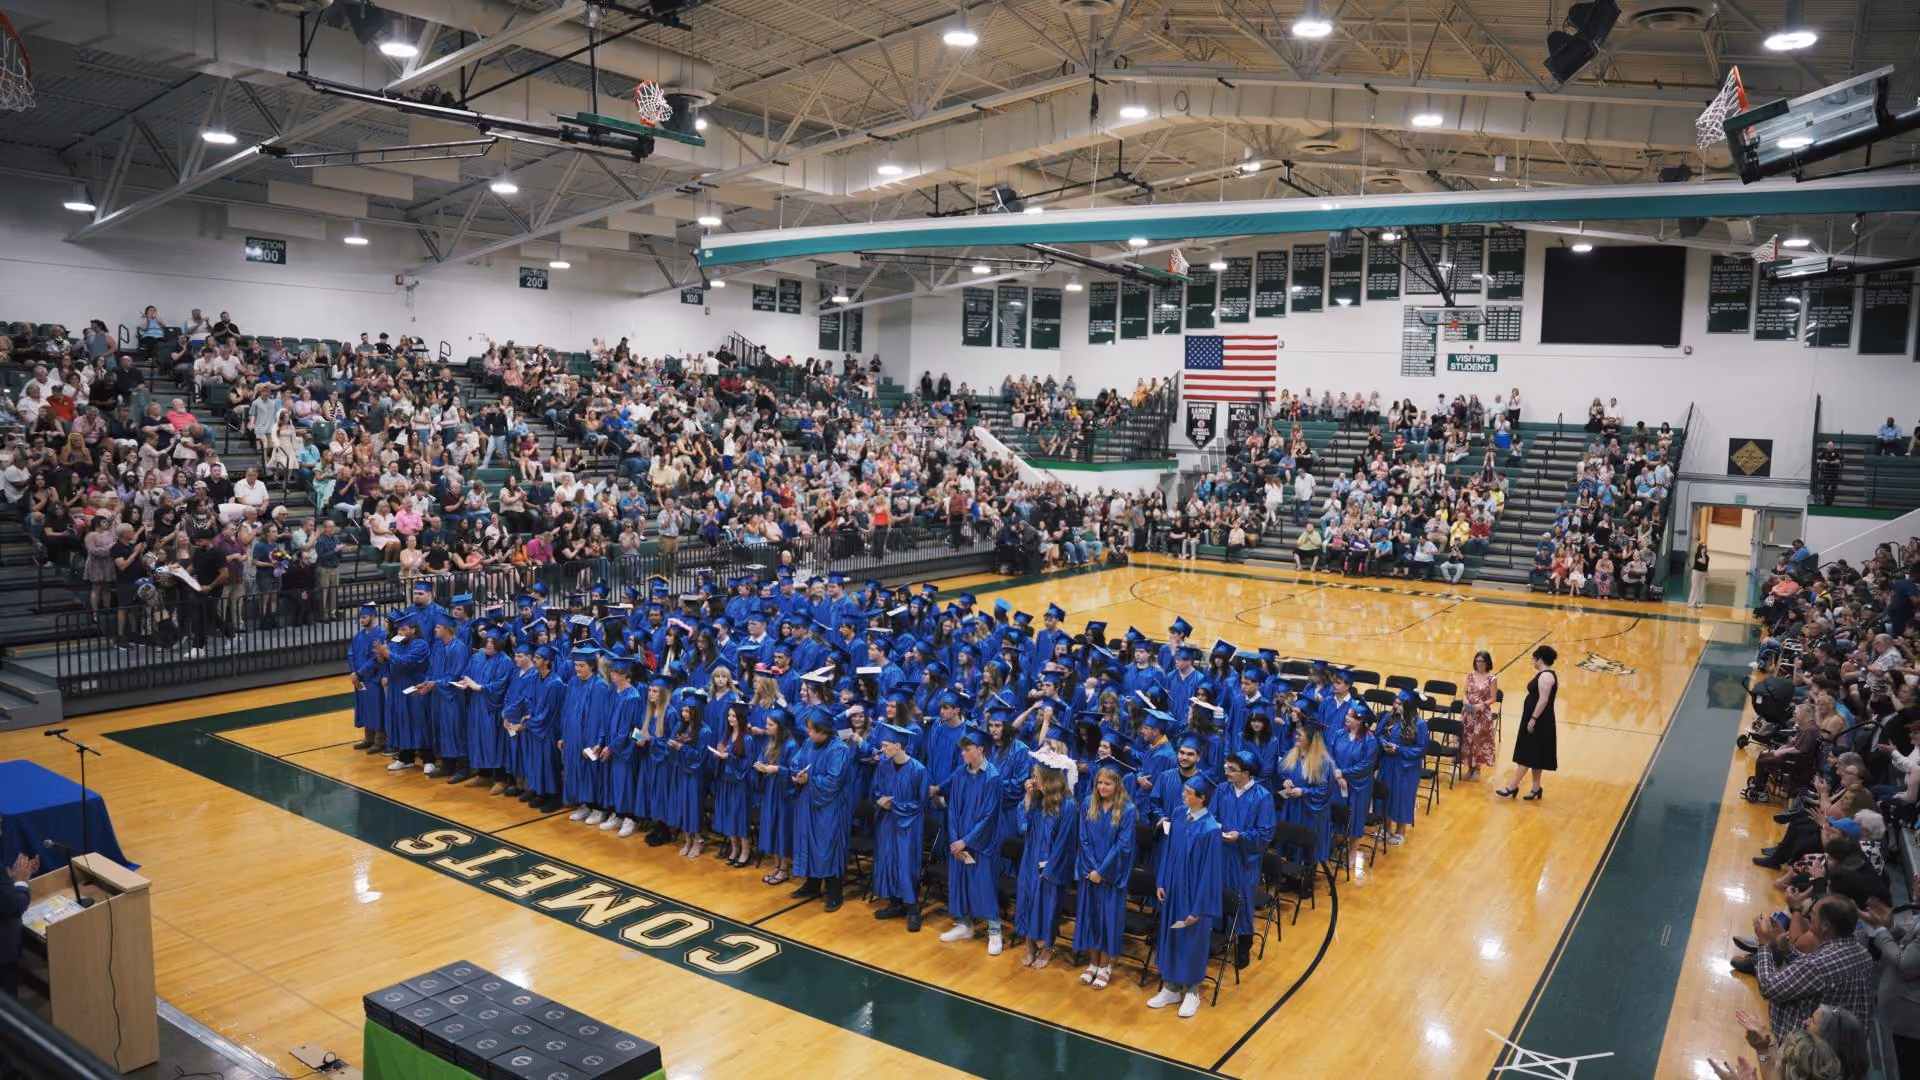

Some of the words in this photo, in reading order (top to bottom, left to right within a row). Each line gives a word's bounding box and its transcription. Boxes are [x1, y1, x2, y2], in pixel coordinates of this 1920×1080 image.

[248, 239, 284, 250] SECTION
[526, 276, 543, 288] 200
[686, 293, 699, 304] 100
[1455, 354, 1491, 363] VISITING
[1450, 362, 1495, 372] STUDENTS
[390, 827, 782, 974] COMETS
